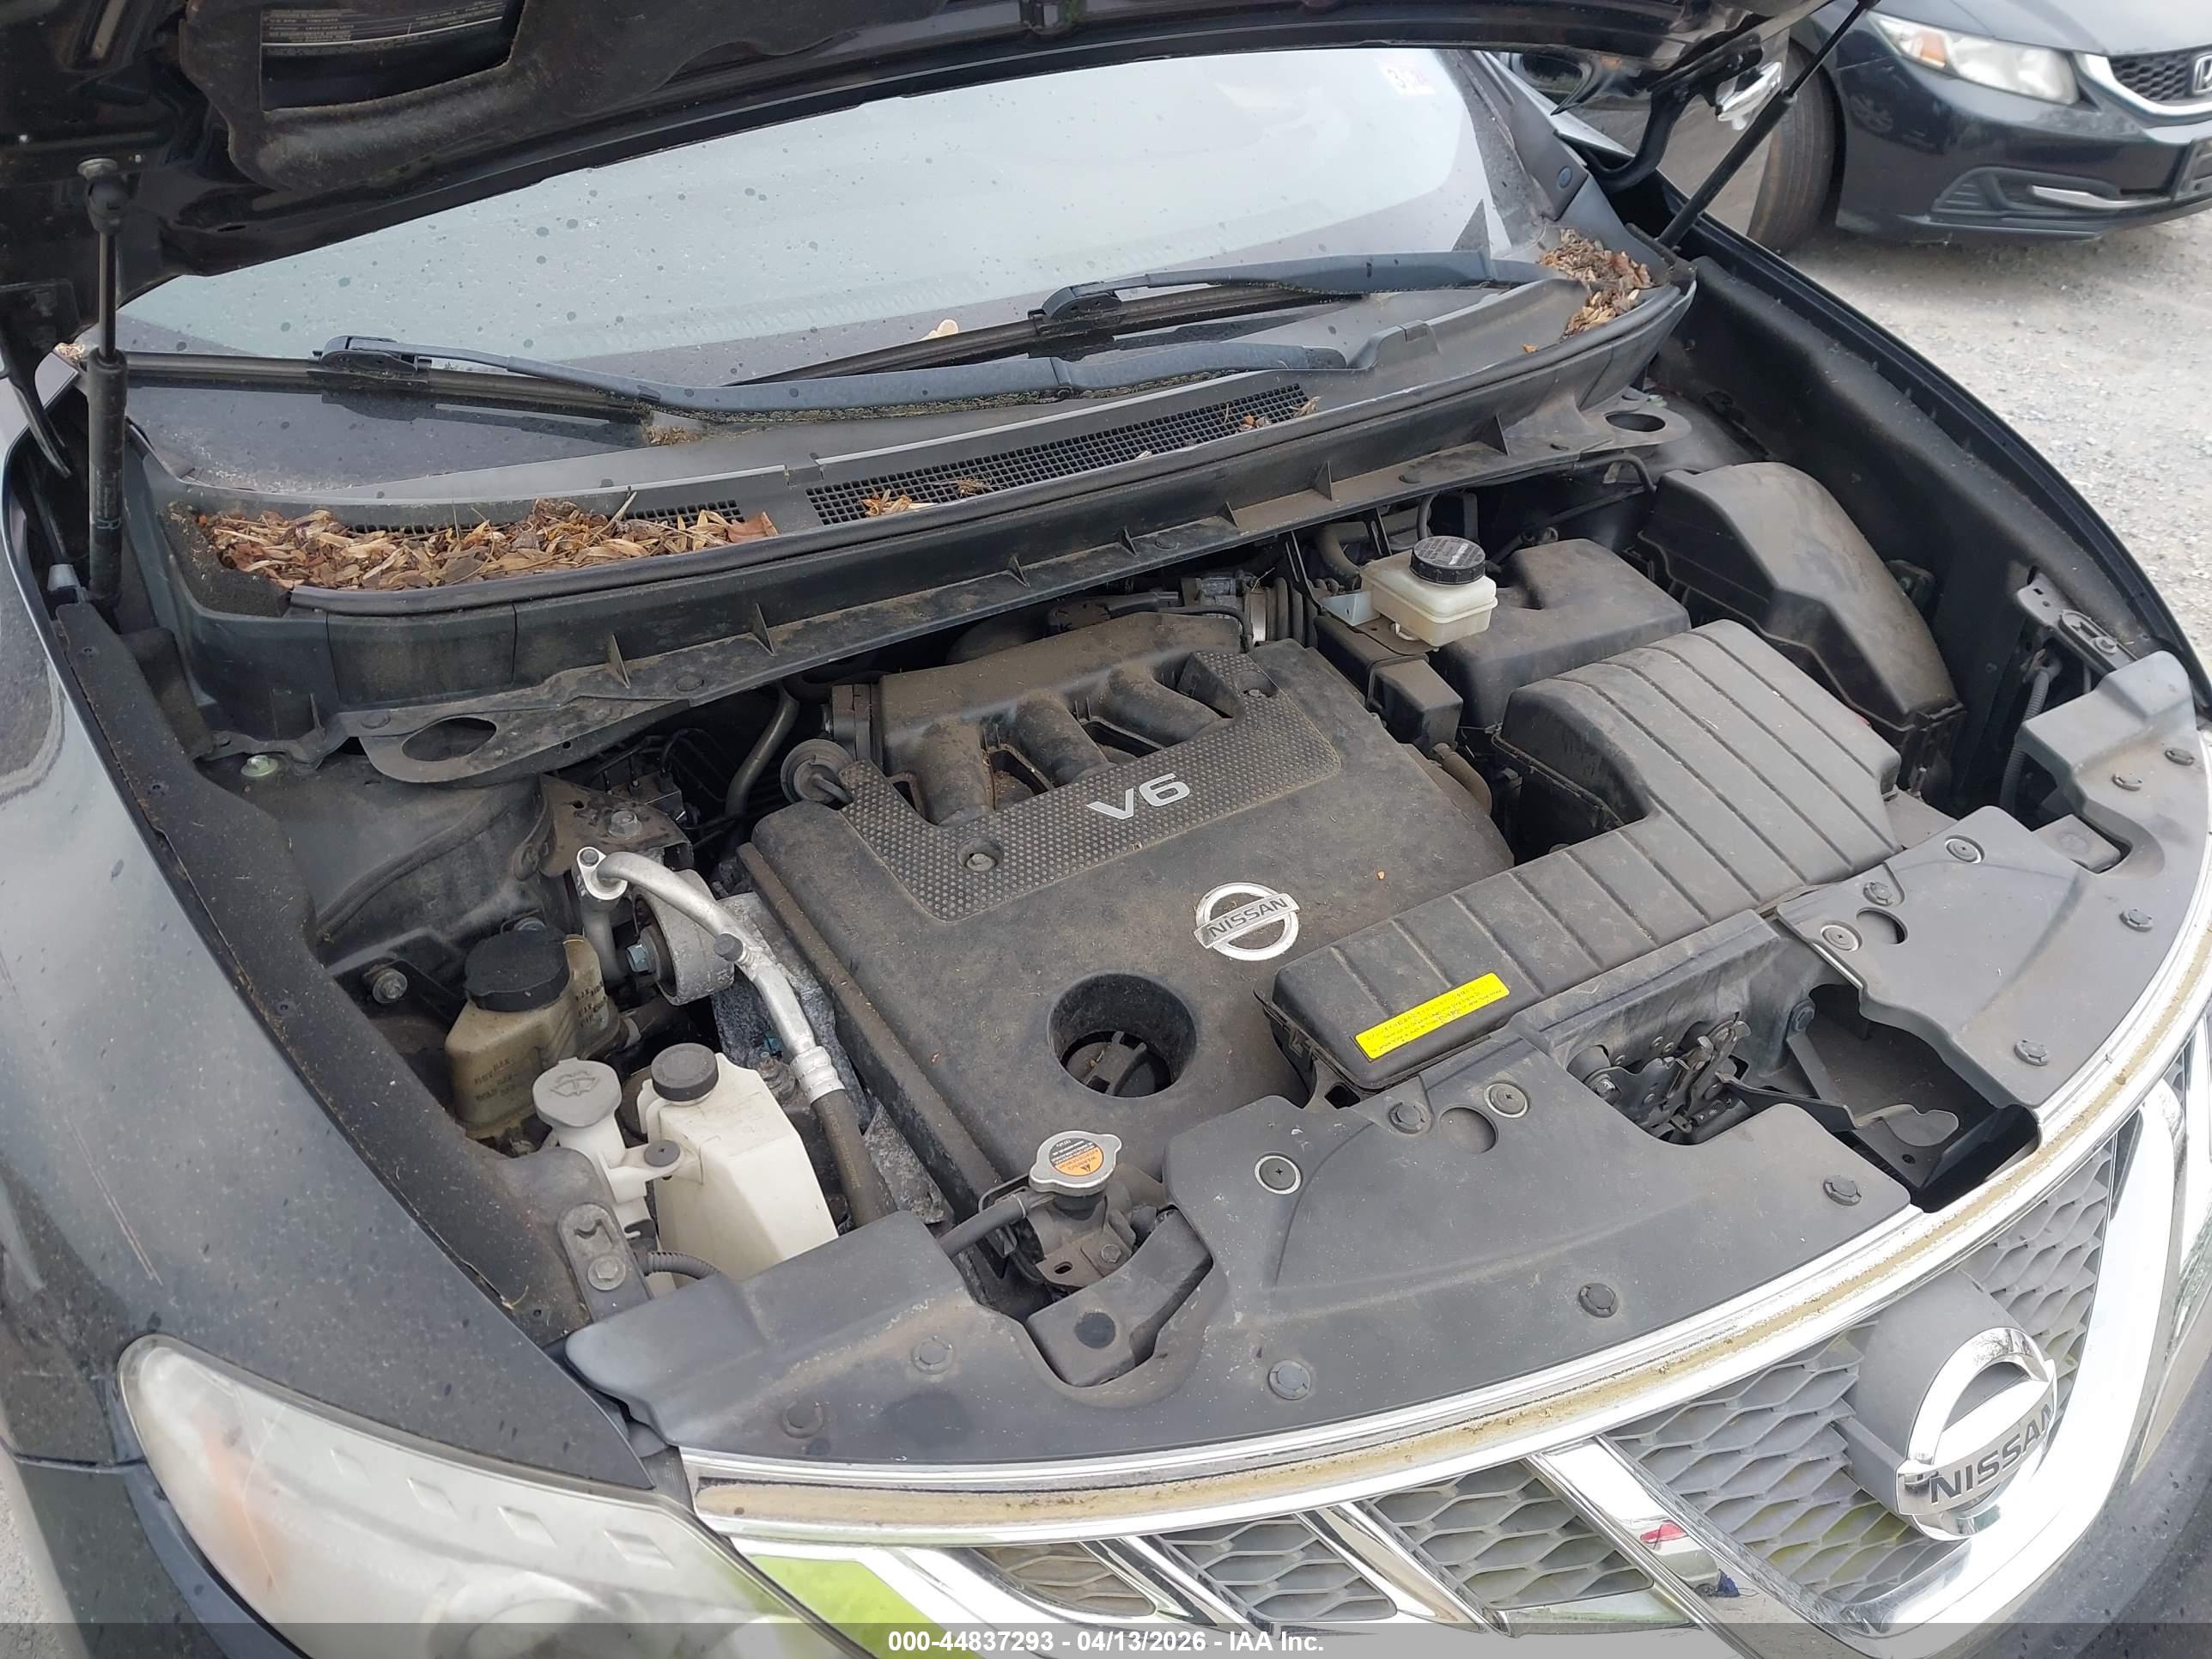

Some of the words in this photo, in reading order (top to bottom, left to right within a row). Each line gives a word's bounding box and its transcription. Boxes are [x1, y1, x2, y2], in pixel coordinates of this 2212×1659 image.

[1085, 772, 1190, 820] V6
[1207, 896, 1289, 938] NISSAN
[1929, 1402, 2054, 1504] NISSAN
